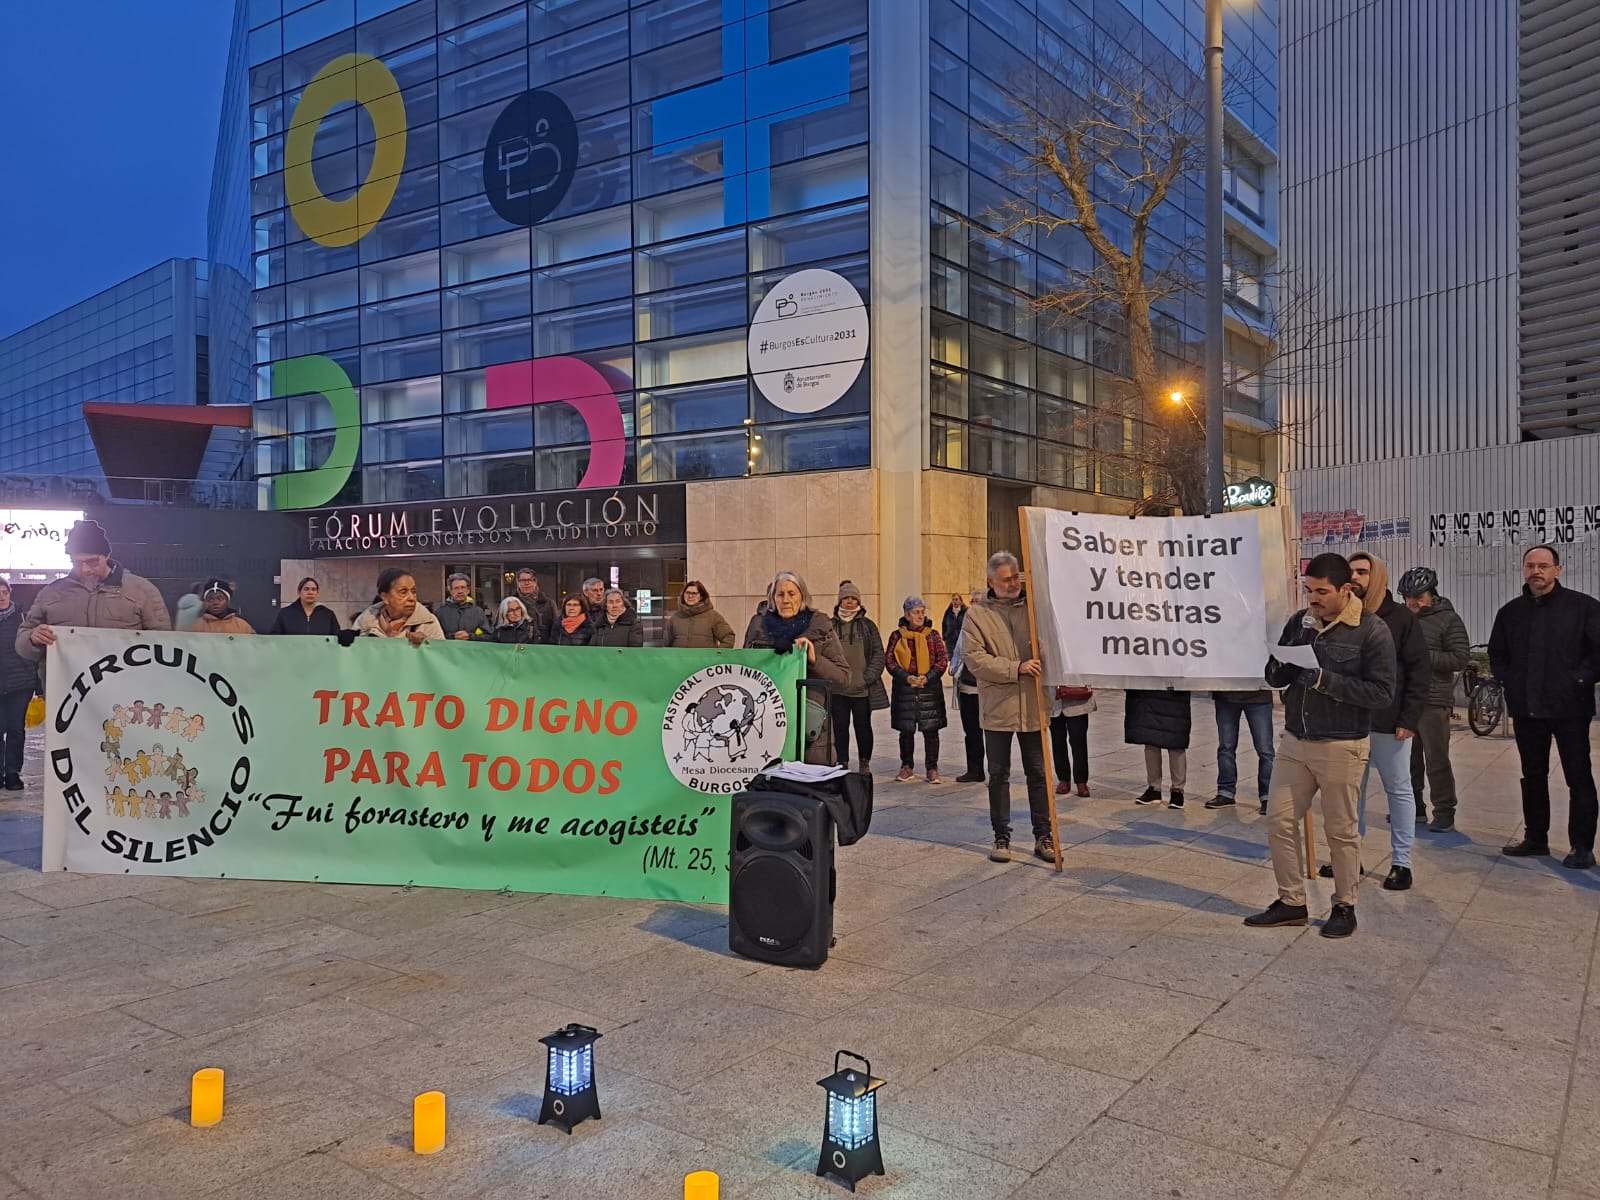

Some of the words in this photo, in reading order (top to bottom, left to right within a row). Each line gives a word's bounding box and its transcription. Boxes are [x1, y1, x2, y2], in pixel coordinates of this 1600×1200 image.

[760, 329, 856, 354] #BurgosEsCultura2031
[308, 510, 408, 539] FÓRUM
[431, 490, 659, 534] EVOLUCIÓN
[1430, 514, 1446, 530] NO
[1454, 513, 1470, 529] NO
[1477, 511, 1494, 528] NO
[1502, 510, 1520, 527] NO
[1528, 508, 1546, 526] NO
[1556, 506, 1574, 524] NO
[309, 536, 371, 550] PALACIO
[379, 535, 397, 549] DE
[407, 528, 512, 547] CONGRESOS
[524, 528, 533, 542] Y
[545, 521, 657, 541] AUDITORIO
[1062, 526, 1147, 557] Saber
[1158, 534, 1243, 557] mirar
[1556, 525, 1574, 543] NO
[1090, 567, 1107, 592] y
[1115, 565, 1216, 590] tender
[1086, 599, 1222, 624] nuestras
[1102, 635, 1208, 658] manos
[55, 644, 255, 745] CIRCULOS
[663, 675, 702, 730] PASTORAL
[706, 665, 732, 678] CON
[740, 666, 786, 728] INMIGRANTES
[312, 690, 465, 730] TRATO
[484, 696, 639, 736] DIGNO
[323, 747, 447, 788] PARA
[462, 753, 623, 795] TODOS
[681, 766, 705, 775] Mesa
[710, 766, 759, 775] Diocesana
[50, 747, 92, 836] DEL
[101, 756, 251, 863] SILENCIO
[345, 796, 469, 834] forastero
[481, 814, 497, 842] y
[507, 815, 550, 834] me
[643, 845, 678, 874] (Mt.
[687, 847, 716, 875] 25,
